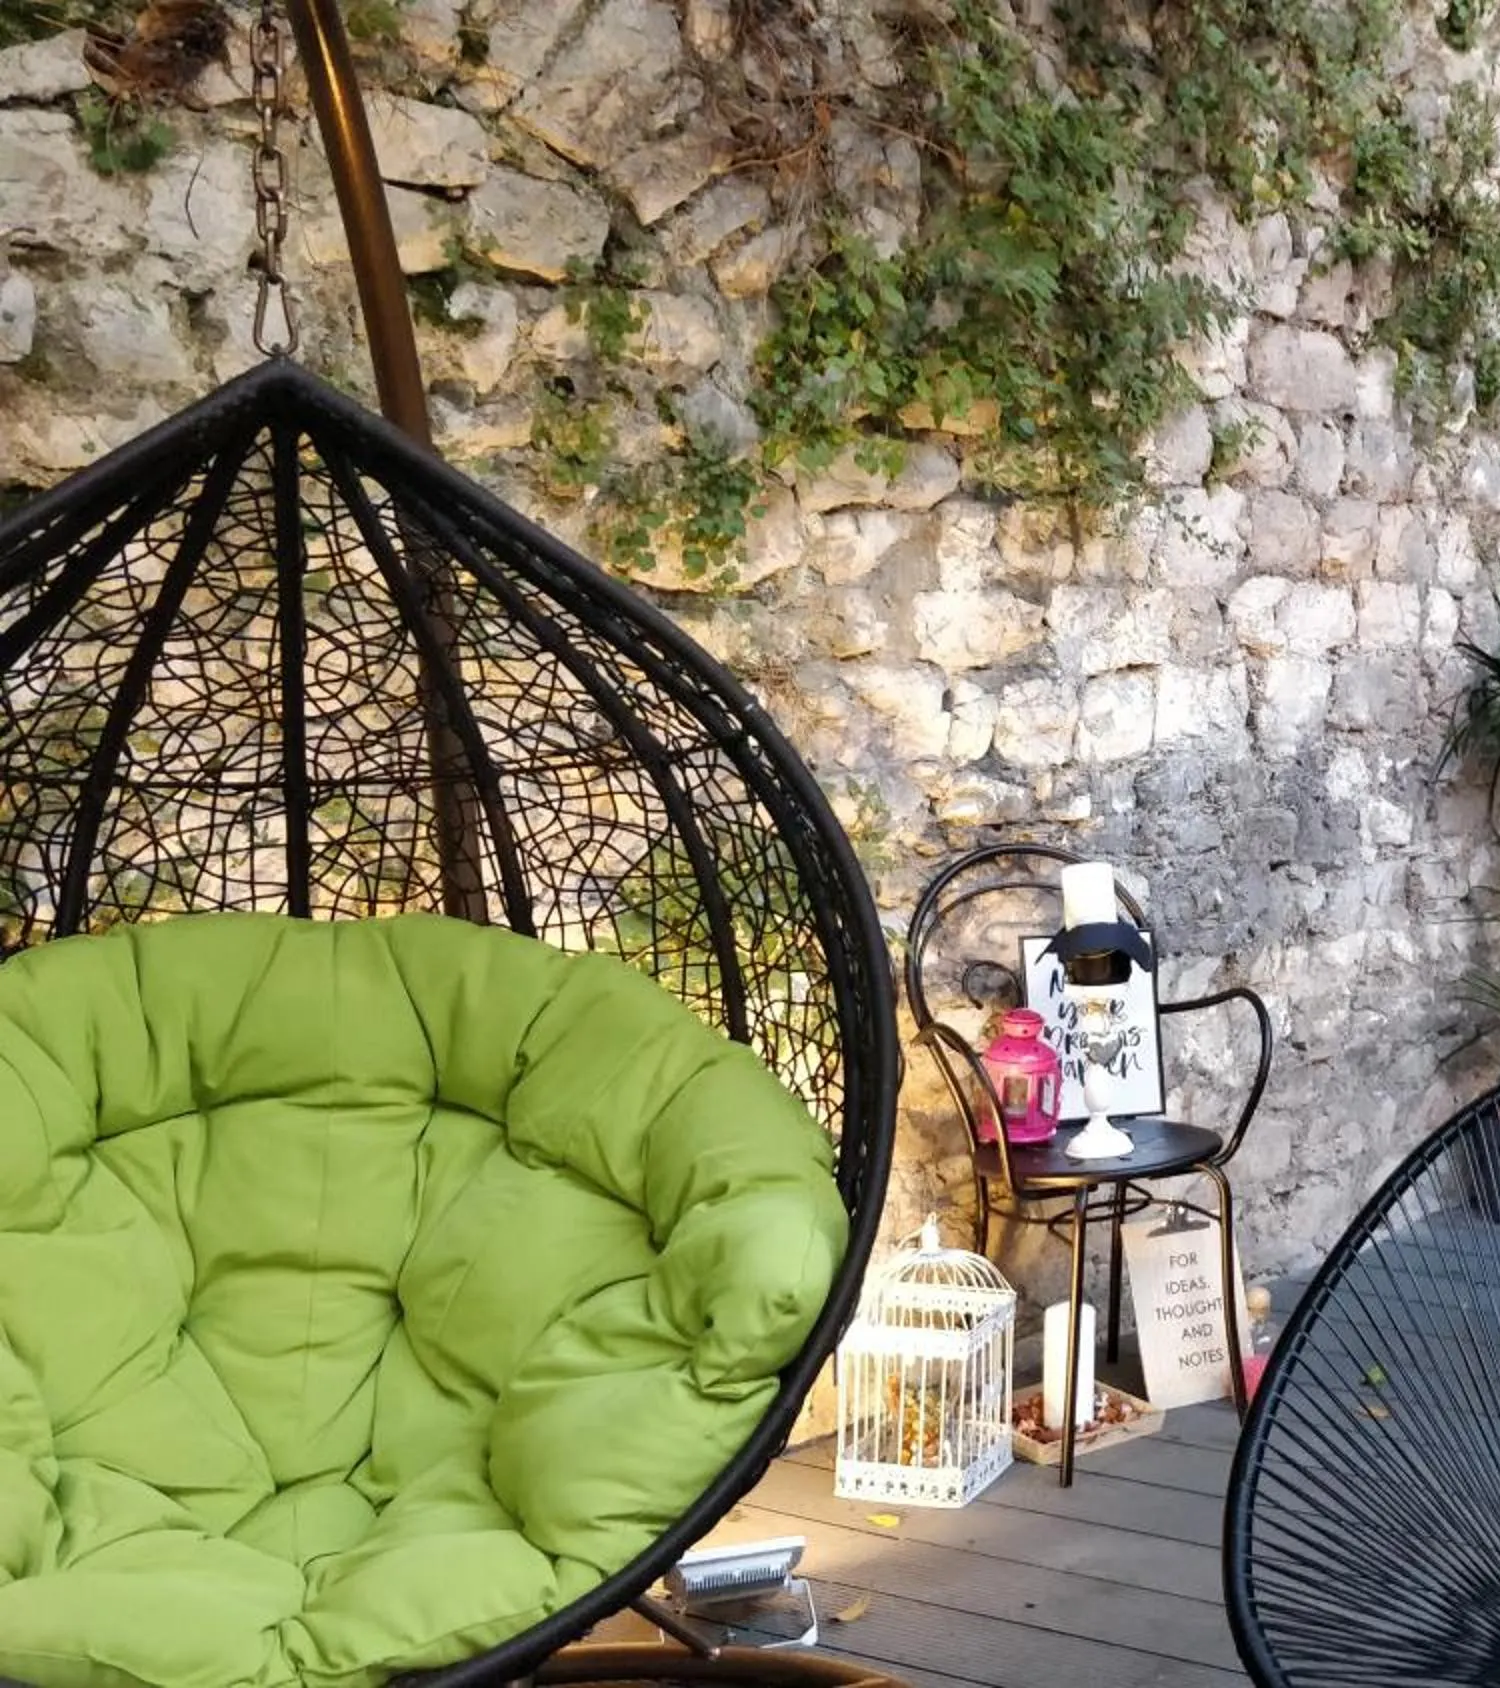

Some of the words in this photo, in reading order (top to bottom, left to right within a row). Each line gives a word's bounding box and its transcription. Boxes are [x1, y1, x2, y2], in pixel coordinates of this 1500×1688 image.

[1169, 1252, 1198, 1270] FOR
[1181, 1323, 1213, 1341] AND
[1179, 1347, 1225, 1370] NOTES
